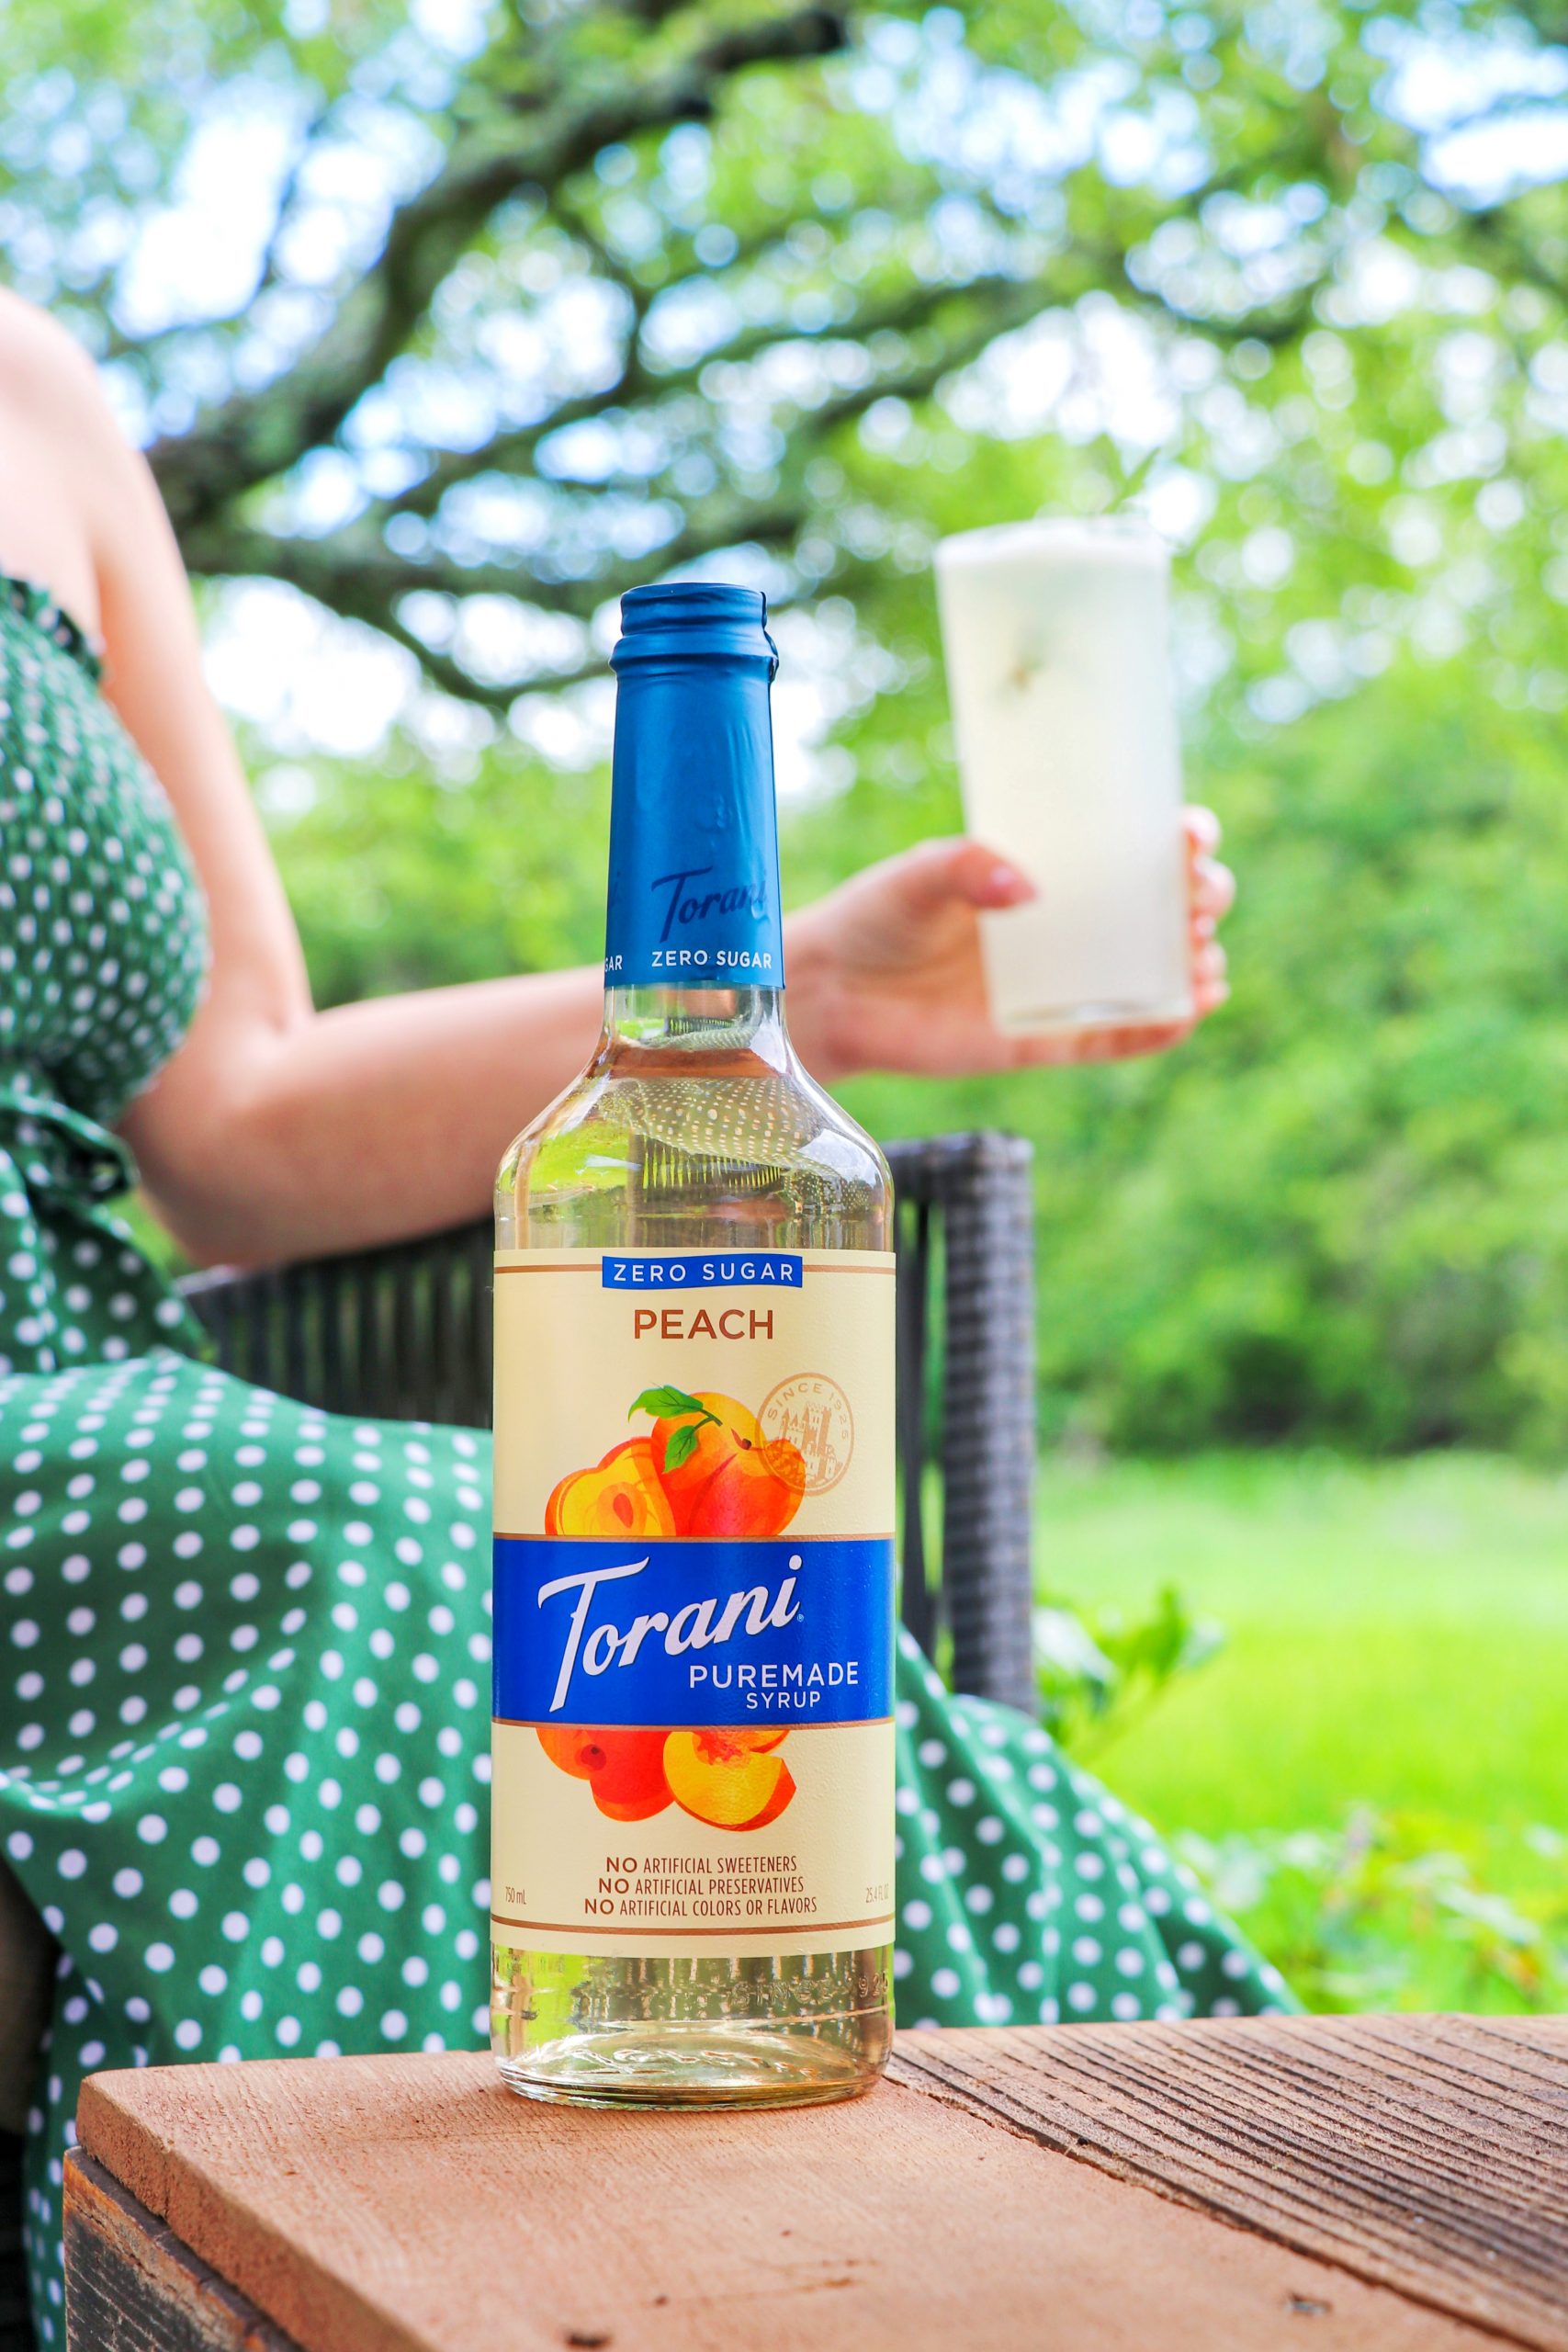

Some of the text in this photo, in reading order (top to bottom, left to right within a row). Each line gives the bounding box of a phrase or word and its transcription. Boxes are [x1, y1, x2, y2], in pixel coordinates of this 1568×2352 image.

[651, 865, 767, 944] Torani
[651, 950, 772, 969] ZERO SUGAR
[614, 1262, 794, 1283] ZERO SUGAR
[634, 1308, 773, 1340] PEACH
[767, 1382, 849, 1440] SINCE 1925
[537, 1554, 803, 1713] Torani
[689, 1661, 859, 1689] PUREMADE
[746, 1691, 821, 1710] SYRUP
[606, 1855, 798, 1874] NO ARTIFICIAL SWEETENERS
[505, 1886, 515, 1904] 750
[598, 1876, 805, 1894] NO ARTIFICIAL PRESERVATIVES
[584, 1896, 818, 1917] NO ARTIFICIAL COLORS OR FLAVORS
